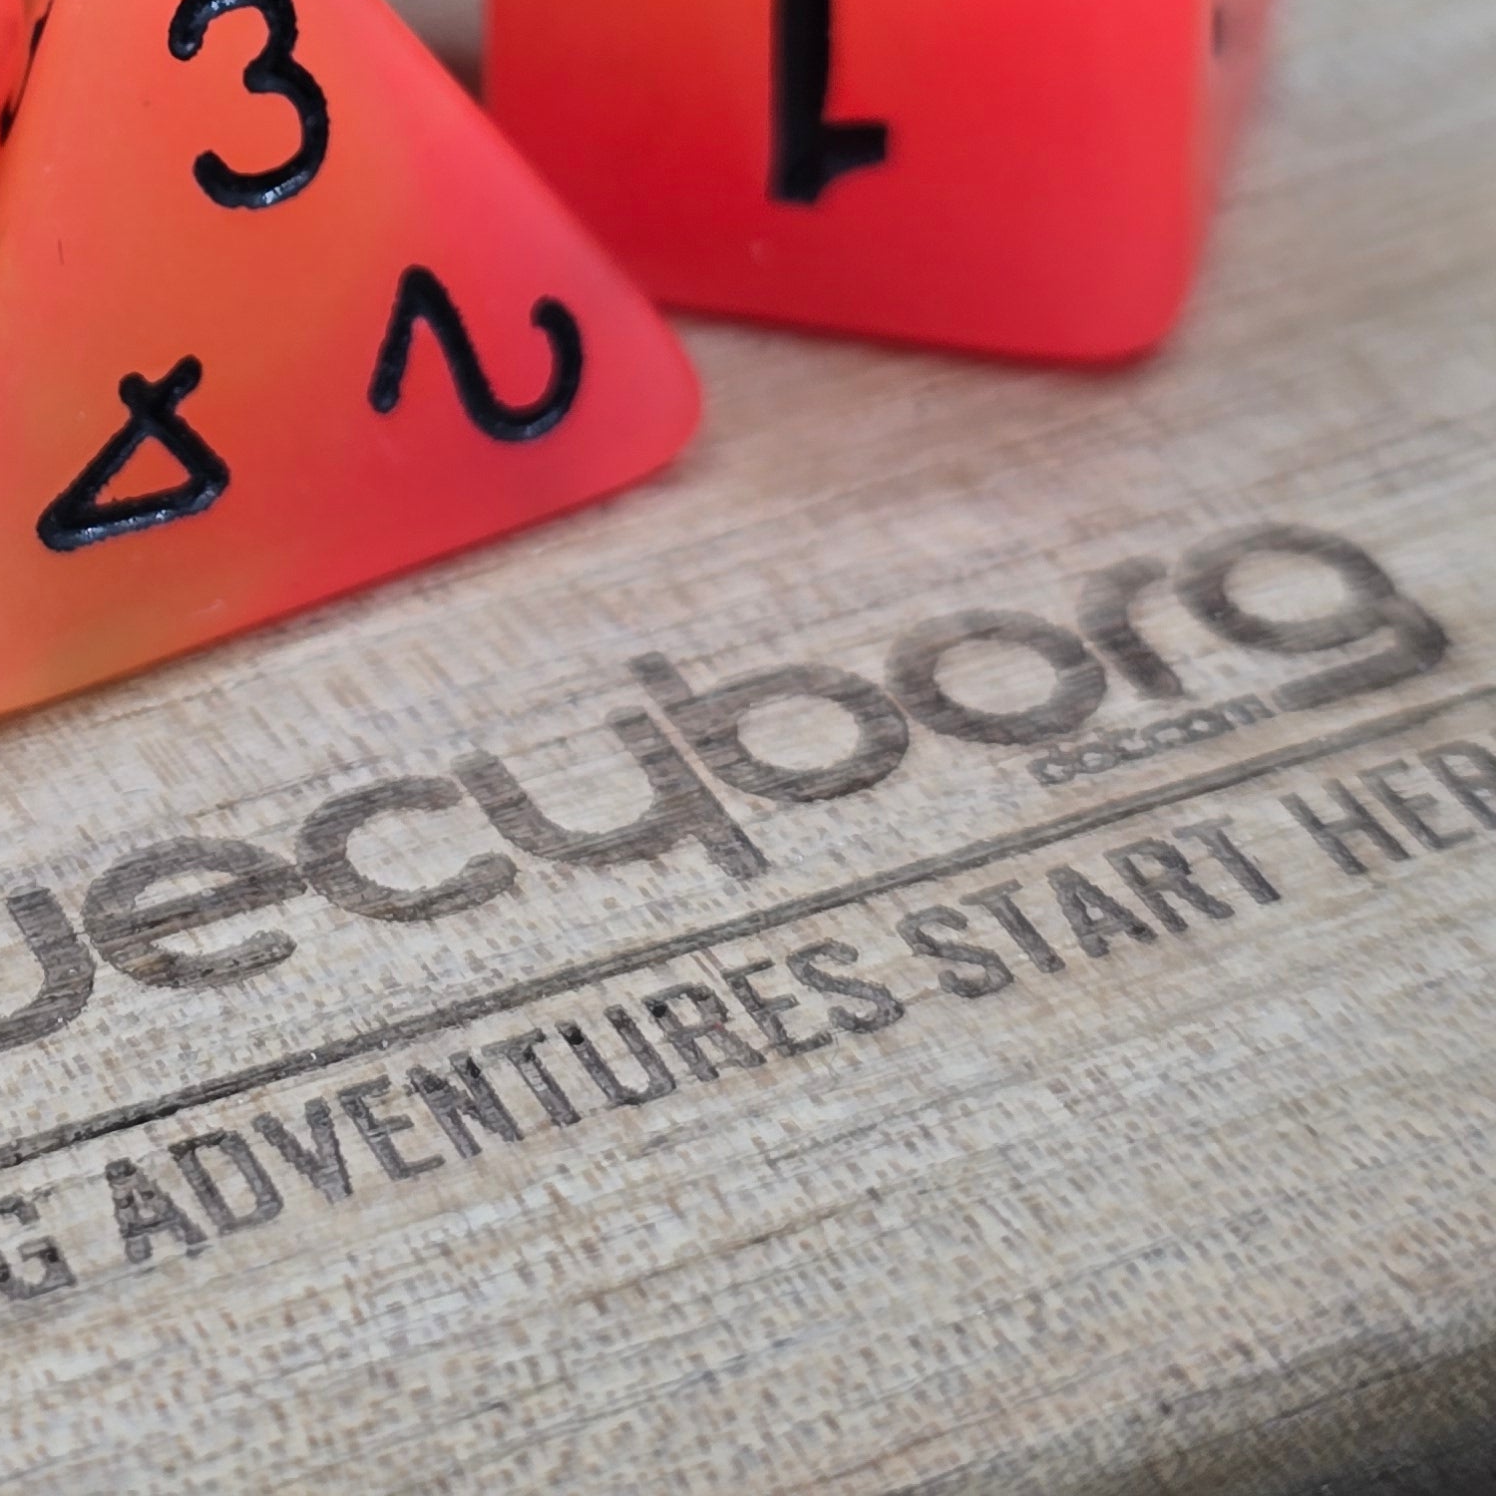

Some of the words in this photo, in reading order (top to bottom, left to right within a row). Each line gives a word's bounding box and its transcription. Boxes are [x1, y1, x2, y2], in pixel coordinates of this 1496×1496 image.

[368, 262, 586, 443] 2
[36, 353, 231, 553] 4
[109, 939, 906, 1267] ADVENTURES
[896, 814, 1282, 1002] START
